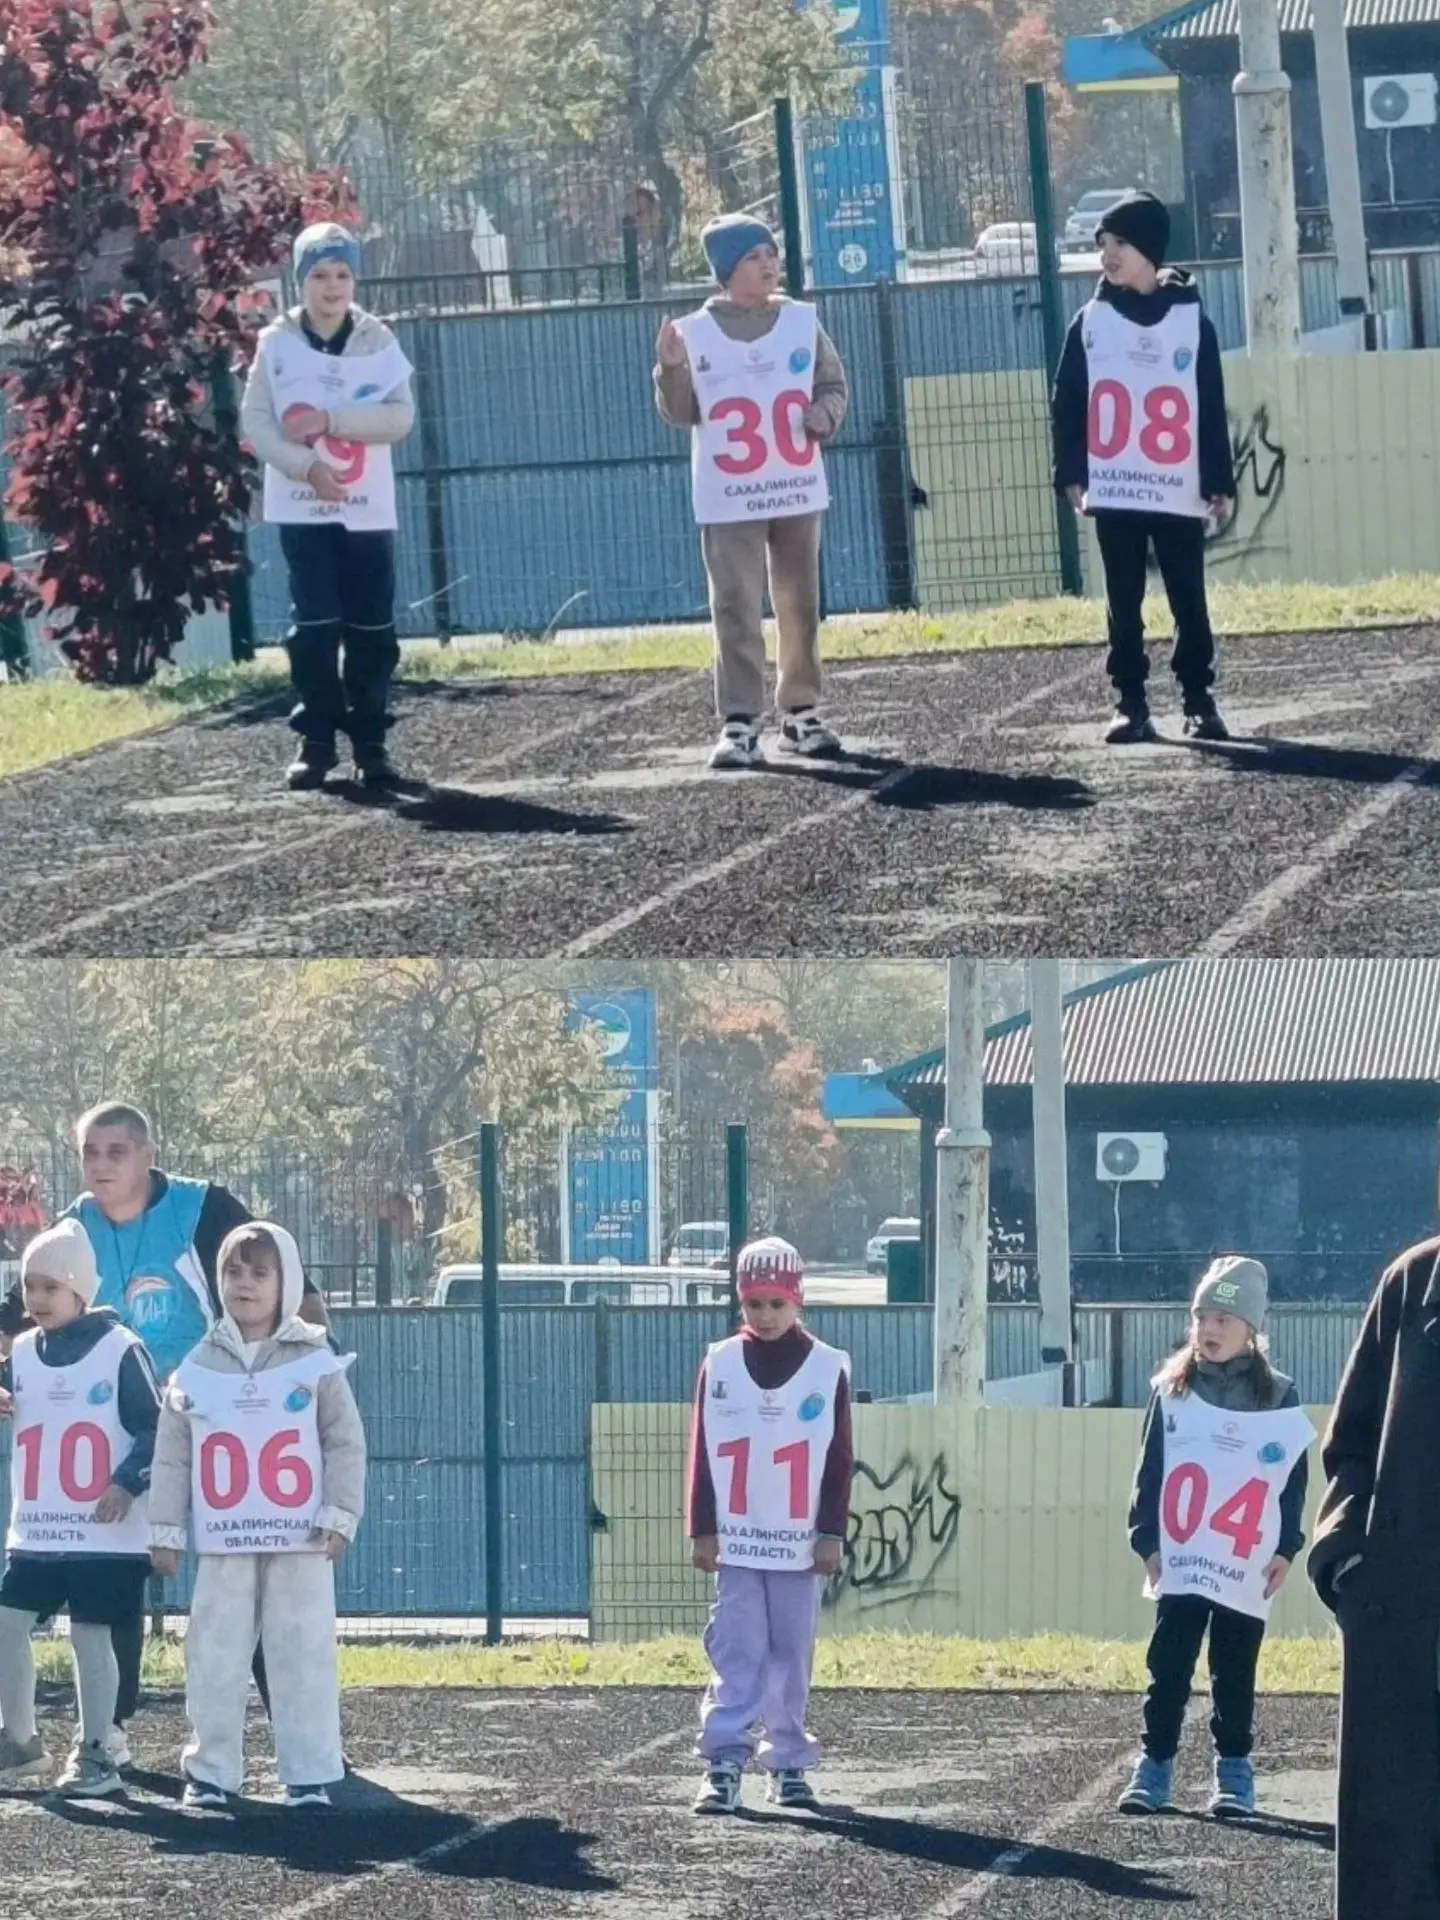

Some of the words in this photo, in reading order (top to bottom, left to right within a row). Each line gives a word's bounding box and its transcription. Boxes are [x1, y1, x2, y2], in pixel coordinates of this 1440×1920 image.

[1088, 378, 1192, 465] 08
[708, 389, 815, 475] 30
[1091, 468, 1184, 488] АХАЛИНСКАЯ
[747, 493, 809, 512] ОБЛАСТЬ
[1098, 485, 1164, 503] ОБЛАСТЬ
[17, 1421, 111, 1502] 10
[201, 1429, 313, 1511] 06
[716, 1437, 809, 1519] 11
[1163, 1462, 1270, 1560] 04
[206, 1518, 311, 1534] САХАЛИНСКАЯ
[719, 1523, 814, 1542] АХАЛИНСКАЯ
[225, 1534, 291, 1549] ОБЛАСТЬ
[727, 1542, 797, 1561] ОБЛАСТЬ
